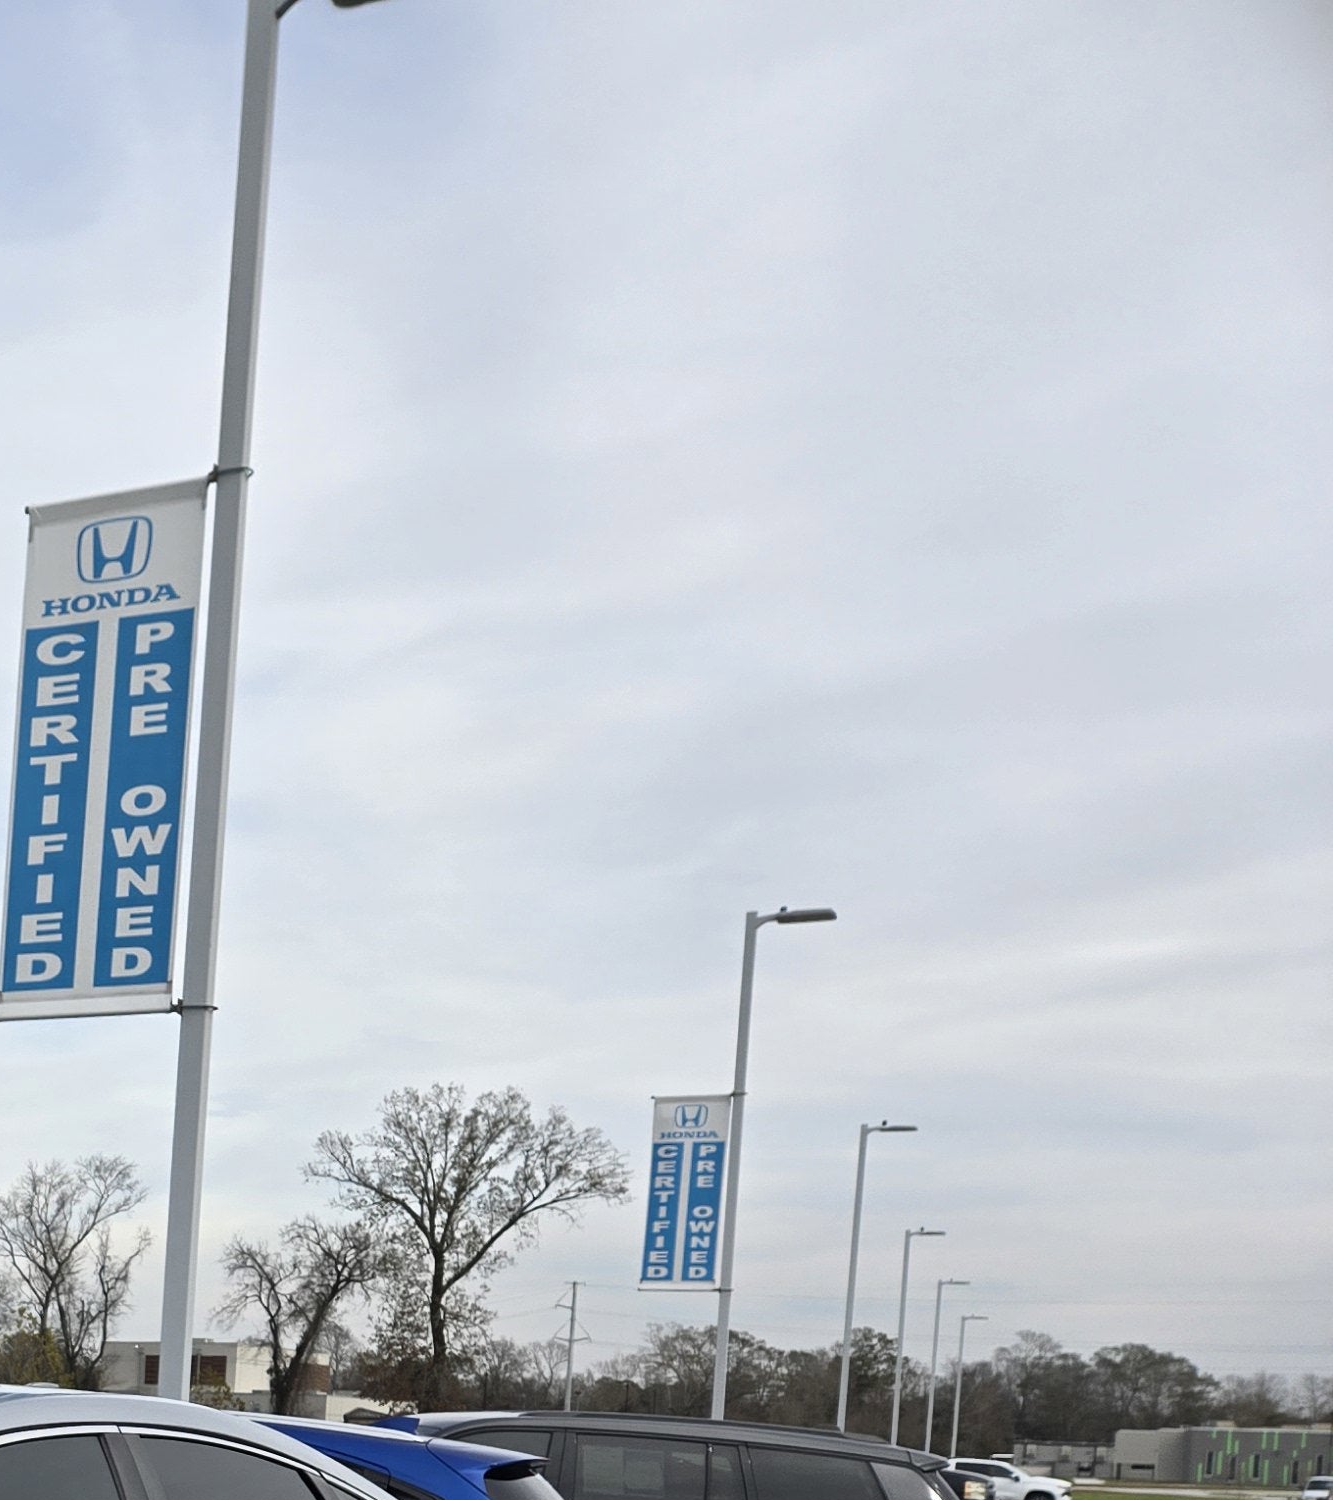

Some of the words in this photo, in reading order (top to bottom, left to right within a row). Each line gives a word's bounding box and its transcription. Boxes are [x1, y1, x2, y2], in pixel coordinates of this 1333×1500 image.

[41, 583, 181, 617] HONDA
[128, 621, 175, 737] PRE
[14, 632, 86, 985] CERTIFIED
[110, 783, 172, 979] OWNED
[659, 1130, 719, 1139] HONDA
[646, 1144, 679, 1279] CERTIFIED
[688, 1205, 715, 1279] OWNED
